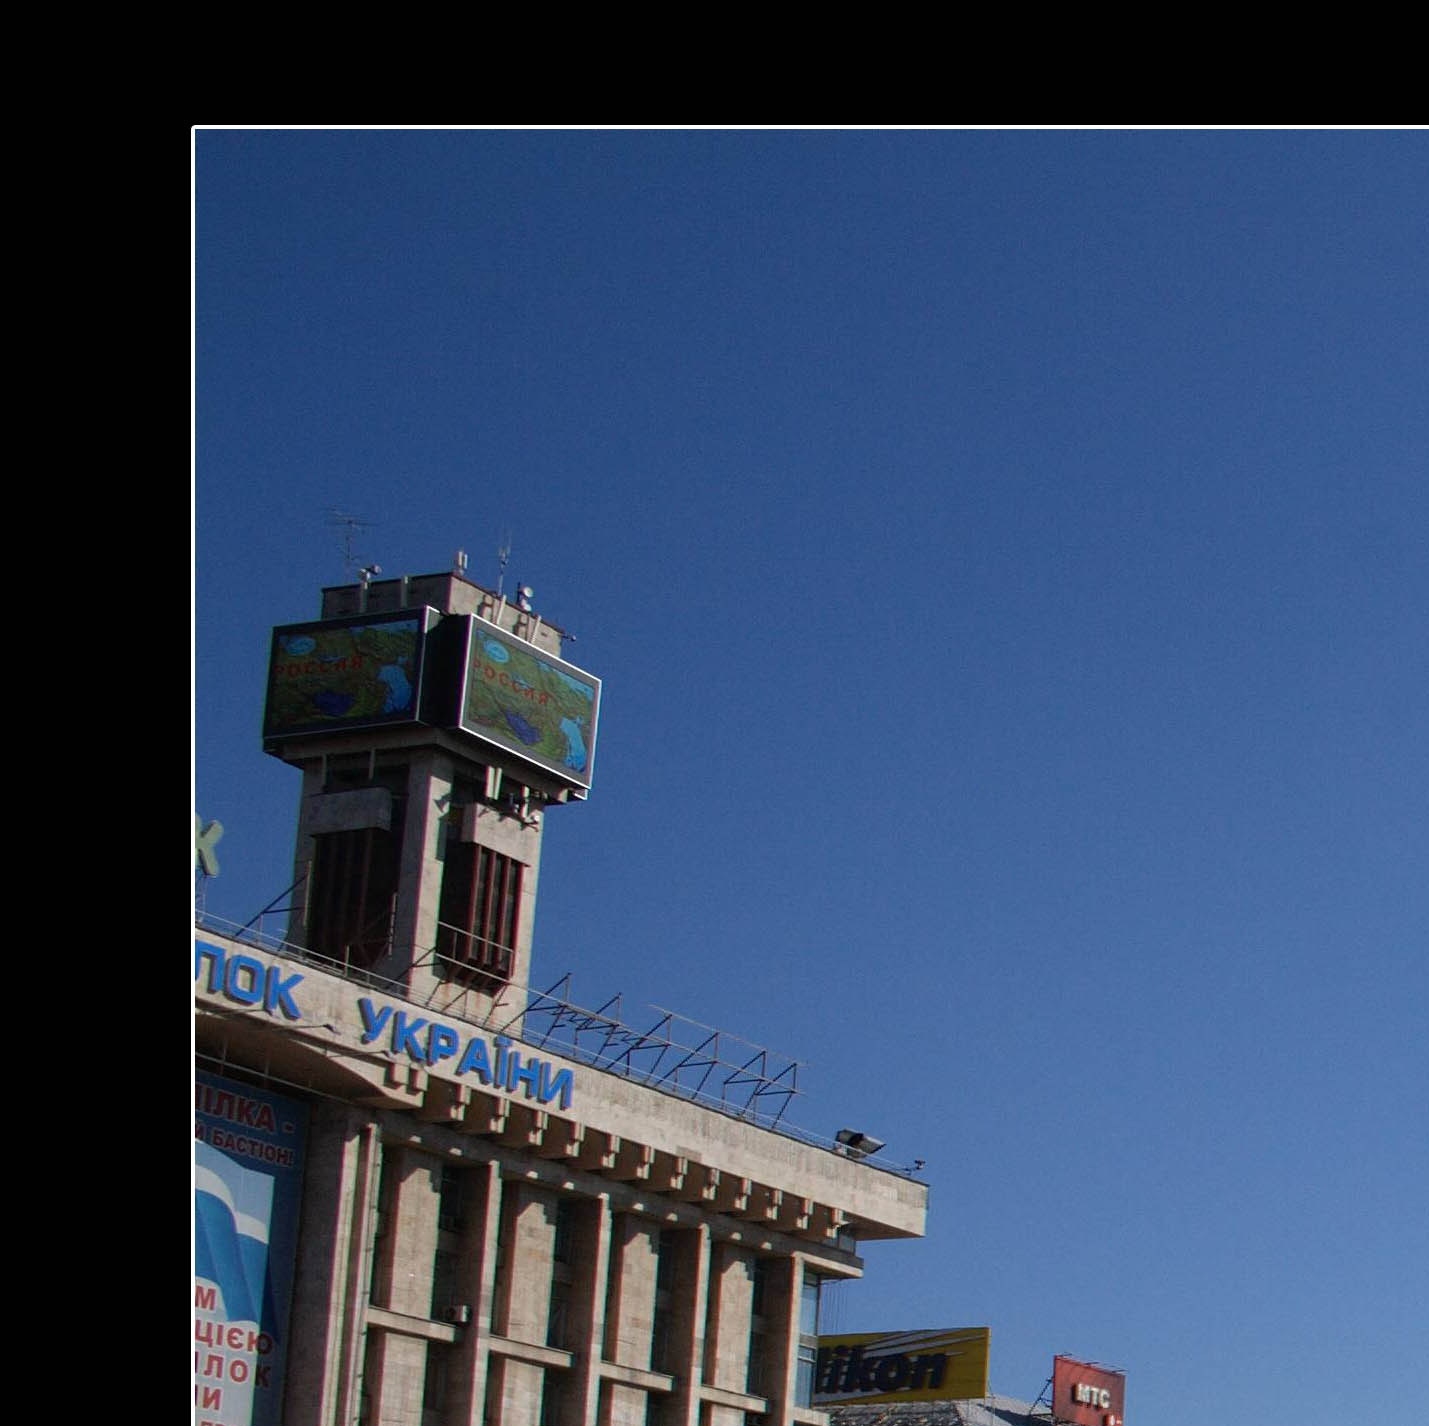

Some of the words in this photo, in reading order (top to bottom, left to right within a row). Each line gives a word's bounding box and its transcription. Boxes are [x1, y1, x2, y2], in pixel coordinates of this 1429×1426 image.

[473, 659, 552, 705] РОССИЯ
[357, 996, 574, 1111] УКРАЇНИ
[212, 1128, 296, 1168] БАСТІОН!
[1074, 1383, 1111, 1409] МТС
